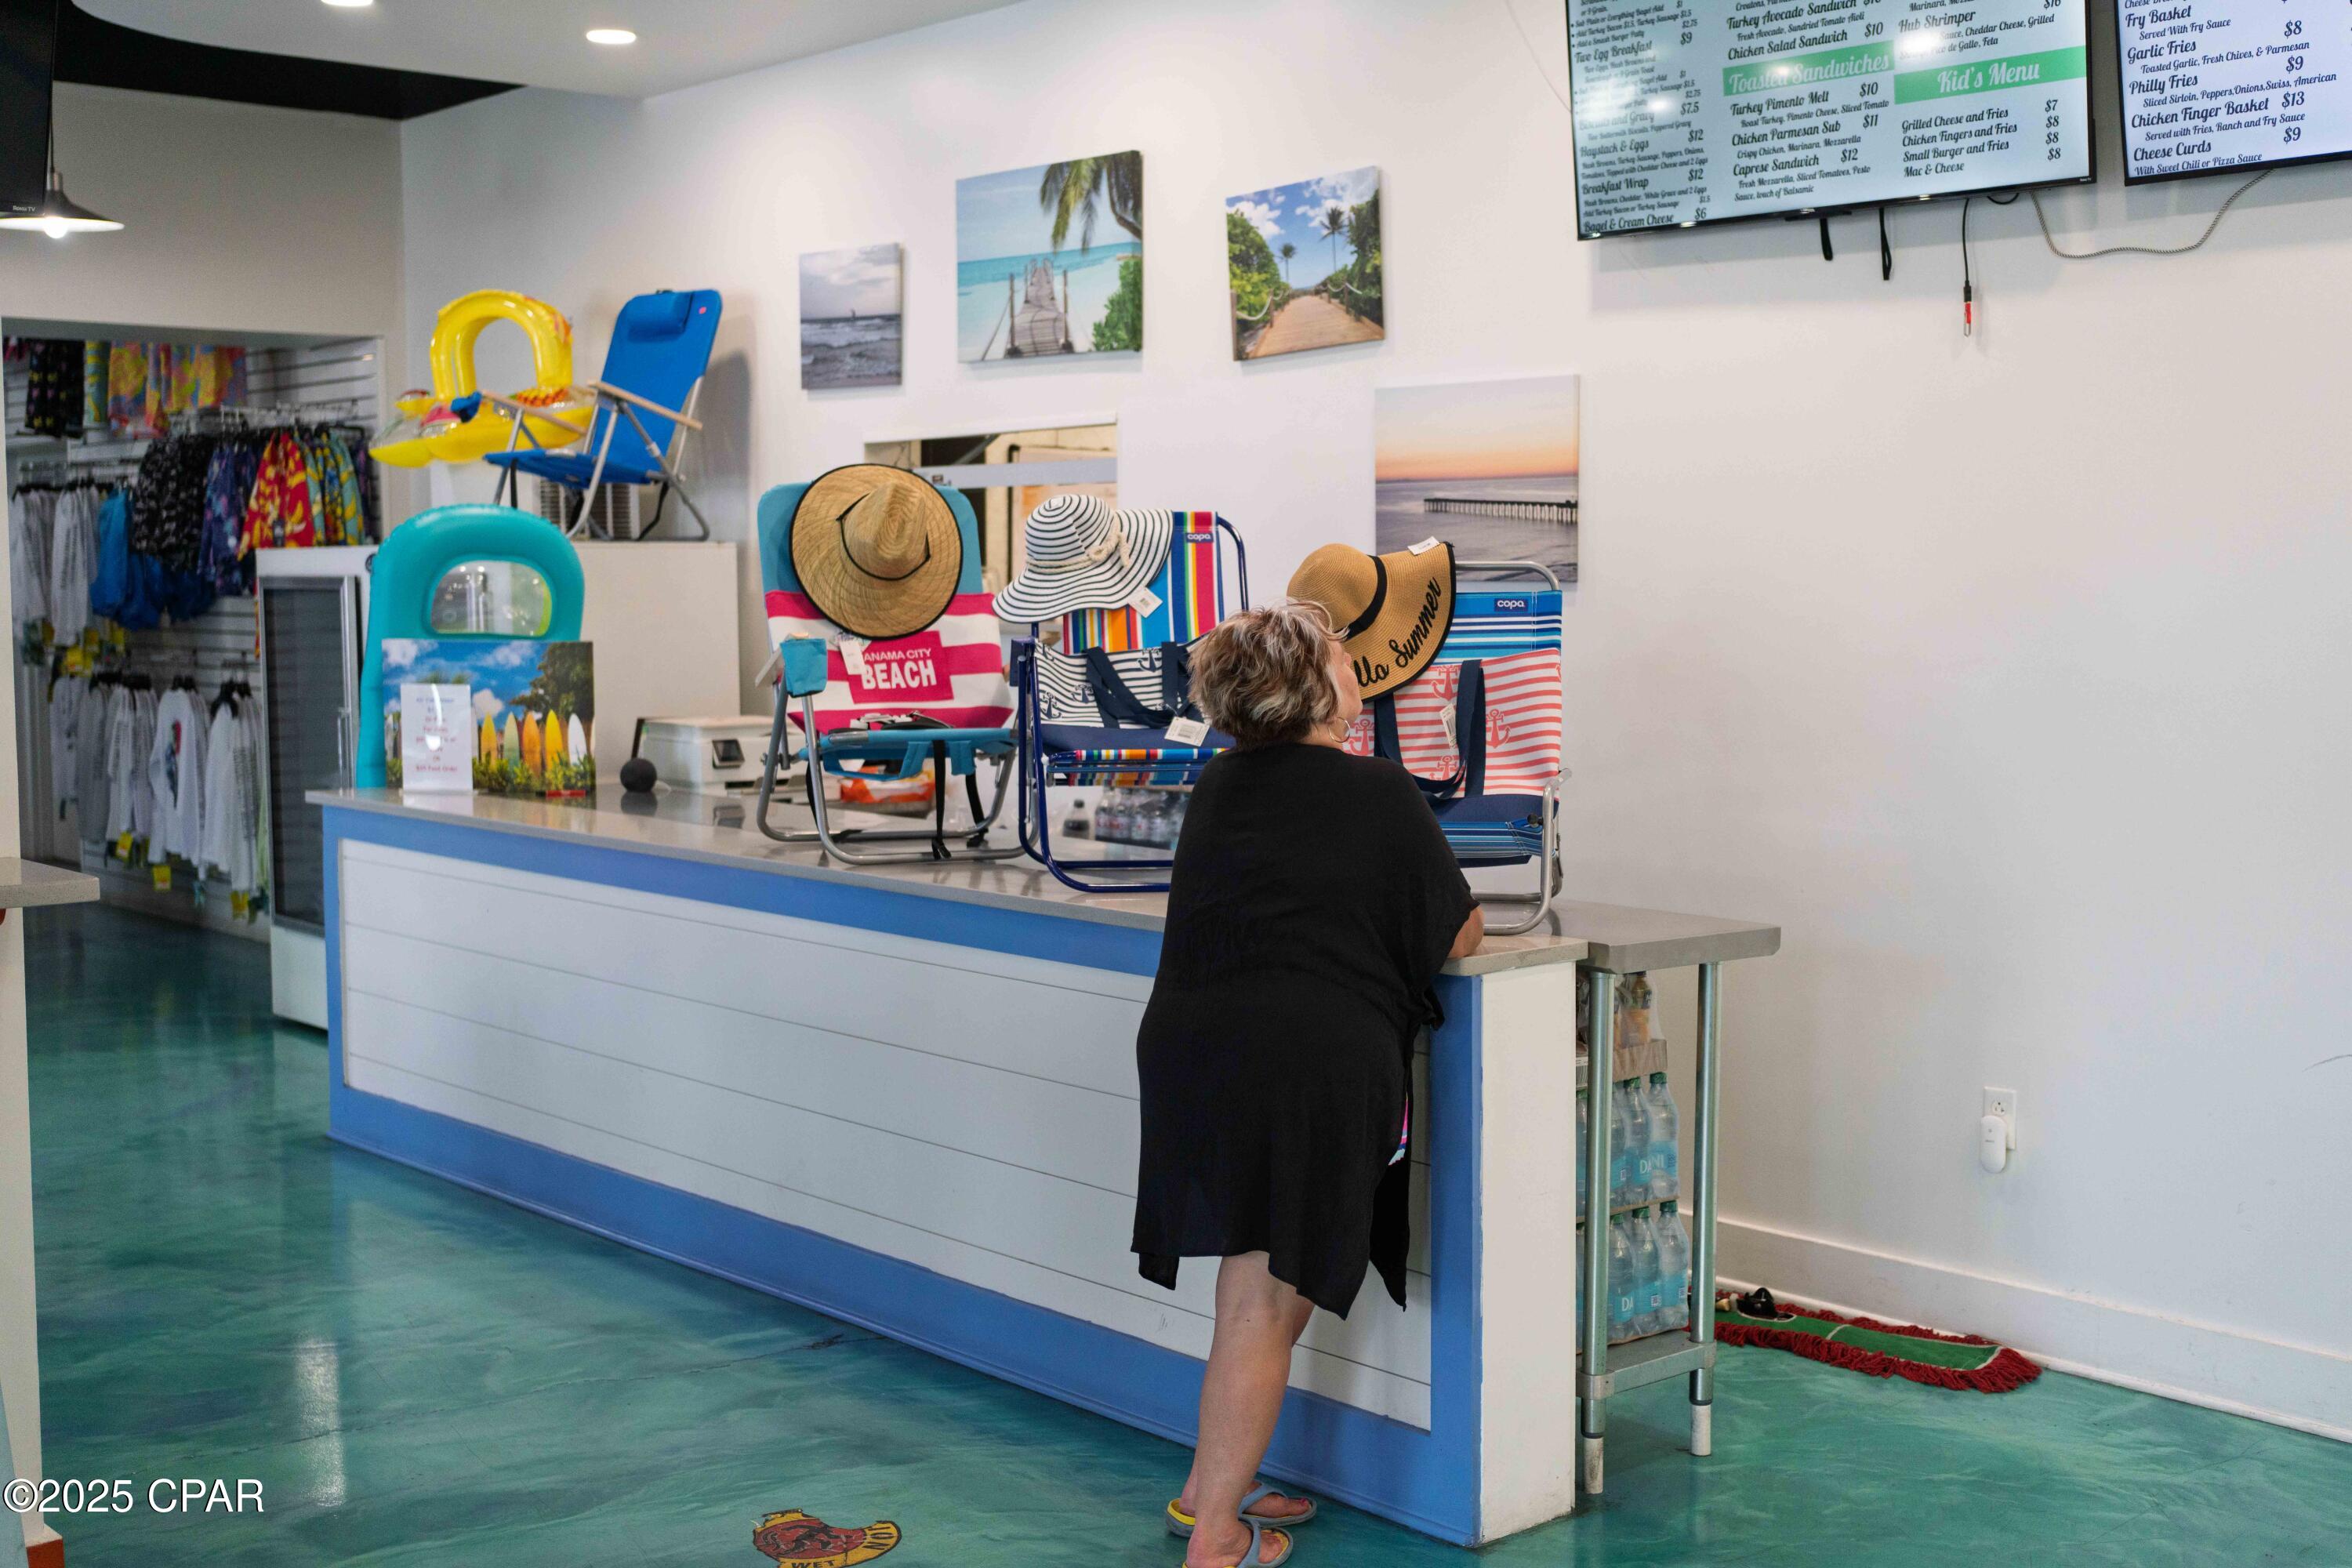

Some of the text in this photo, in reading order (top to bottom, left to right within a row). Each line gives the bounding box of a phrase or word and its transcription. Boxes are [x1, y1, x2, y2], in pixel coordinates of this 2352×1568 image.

[1726, 13, 1760, 30] Turkey
[1762, 7, 1803, 24] Avocado
[1807, 0, 1857, 16] Sandwich
[1909, 0, 1947, 12] Marinara,
[1737, 11, 1864, 42] Fresh Avocado, Sundried Tomato Aioli
[1898, 10, 1976, 33] Hub Shrimper
[1940, 14, 2055, 40] Sauce, Cheddar Cheese, Grilled
[2125, 5, 2192, 29] Fry Basket
[1680, 31, 1693, 46] $9
[1864, 22, 1883, 39] $10
[2140, 18, 2231, 41] Served With Fry Sauce
[2285, 20, 2303, 38] $8
[1575, 41, 1653, 64] Two Egg Breakfast
[1728, 29, 1848, 60] Chicken Salad Sandwich
[1947, 42, 1958, 53] de
[1958, 39, 1981, 52] Gallo,
[1982, 36, 1998, 46] Feta
[2127, 39, 2197, 65] Garlic Fries
[2141, 41, 2310, 74] Toasted Garlic, Fresh Chives, & Parmesan
[2286, 56, 2303, 73] $9
[1729, 53, 1889, 93] Toasted Sandwiches
[1937, 62, 2040, 93] Kid's Menu
[1860, 82, 1878, 98] $10
[2129, 74, 2198, 95] Philly Fries
[2143, 96, 2167, 108] Sliced
[2169, 92, 2199, 104] Sirloin,
[2294, 72, 2336, 87] American
[1680, 102, 1700, 115] $7.5
[1730, 91, 1829, 116] Turkey Pimento Melt
[2045, 100, 2058, 113] $7
[2281, 91, 2305, 110] $13
[1740, 118, 1759, 128] Roast
[1787, 111, 1814, 122] Pimento
[1841, 103, 1862, 113] Sliced
[1863, 100, 1889, 110] Tomato
[1863, 114, 1878, 129] $11
[1902, 107, 2009, 134] Grilled Cheese and Fries
[2045, 115, 2060, 129] $8
[2131, 97, 2270, 129] Chicken Finger Basket
[1688, 129, 1704, 143] $12
[1732, 120, 1841, 146] Chicken Parmesan Sub
[1902, 123, 2017, 147] Chicken Fingers and Fries
[2145, 112, 2306, 142] Served with Fries, Ranch and Fry Sauce
[2283, 126, 2301, 145] $9
[1737, 150, 1758, 159] Crispy
[1824, 135, 1861, 147] Mozzarella
[2045, 132, 2059, 145] $8
[1580, 140, 1650, 159] Haystack & Eggs
[1840, 148, 1858, 164] $12
[1903, 140, 2009, 163] Small Burger and Fries
[2047, 147, 2061, 162] $8
[2133, 140, 2212, 162] Cheese Curds
[1688, 169, 1704, 181] $12
[1733, 154, 1819, 177] Caprese Sandwich
[1904, 161, 1965, 178] Mac & Cheese
[2134, 165, 2155, 176] With
[2156, 162, 2180, 174] Sweet
[2181, 159, 2200, 170] Chili
[2212, 157, 2235, 167] Pizza
[2237, 153, 2263, 164] Sauce
[1582, 179, 1650, 195] Breakfast Wrap
[1738, 180, 1755, 189] Fresh
[1796, 172, 1817, 182] Sliced
[1853, 165, 1871, 174] Pesto
[1756, 190, 1773, 199] touch
[1775, 187, 1782, 198] of
[1783, 184, 1814, 196] Balsamic
[1584, 213, 1675, 233] Bagel & Cream Cheese
[1694, 208, 1707, 220] $6
[1187, 533, 1211, 542] copa
[1497, 600, 1524, 610] copa
[1353, 577, 1442, 688] llo Summer
[864, 648, 931, 662] ANAMA CITY
[862, 659, 937, 690] BEACH
